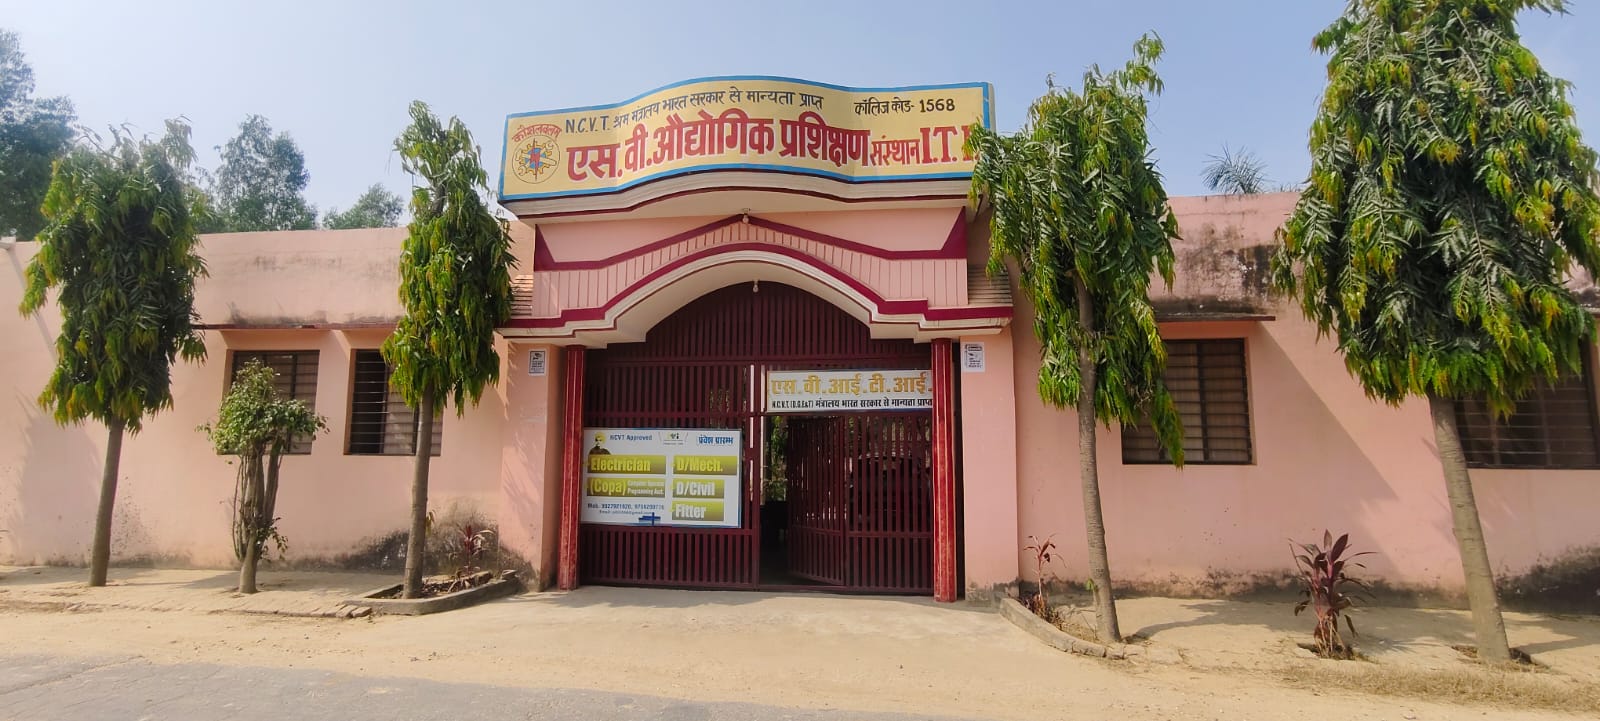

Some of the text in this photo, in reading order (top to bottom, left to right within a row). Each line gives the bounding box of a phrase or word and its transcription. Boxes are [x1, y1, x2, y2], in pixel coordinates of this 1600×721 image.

[613, 113, 630, 129] श्रम
[662, 95, 688, 111] भारत
[689, 90, 726, 106] सरकार
[729, 86, 743, 102] से
[746, 90, 796, 105] मान्यता
[799, 92, 824, 110] प्राप्त
[919, 98, 956, 113] 1568
[779, 111, 871, 167] प्रशिक्षण
[870, 134, 921, 167] संस्थान
[842, 399, 858, 408] भारत
[860, 399, 882, 407] सरकार
[883, 396, 890, 407] से
[891, 398, 916, 407] मान्यता
[626, 434, 653, 442] Approved
[591, 457, 652, 472] Electrician
[676, 457, 724, 472] D/Mech.
[590, 478, 627, 496] (Copa)
[676, 481, 716, 496] D/Civil
[675, 503, 707, 519] Fitter
